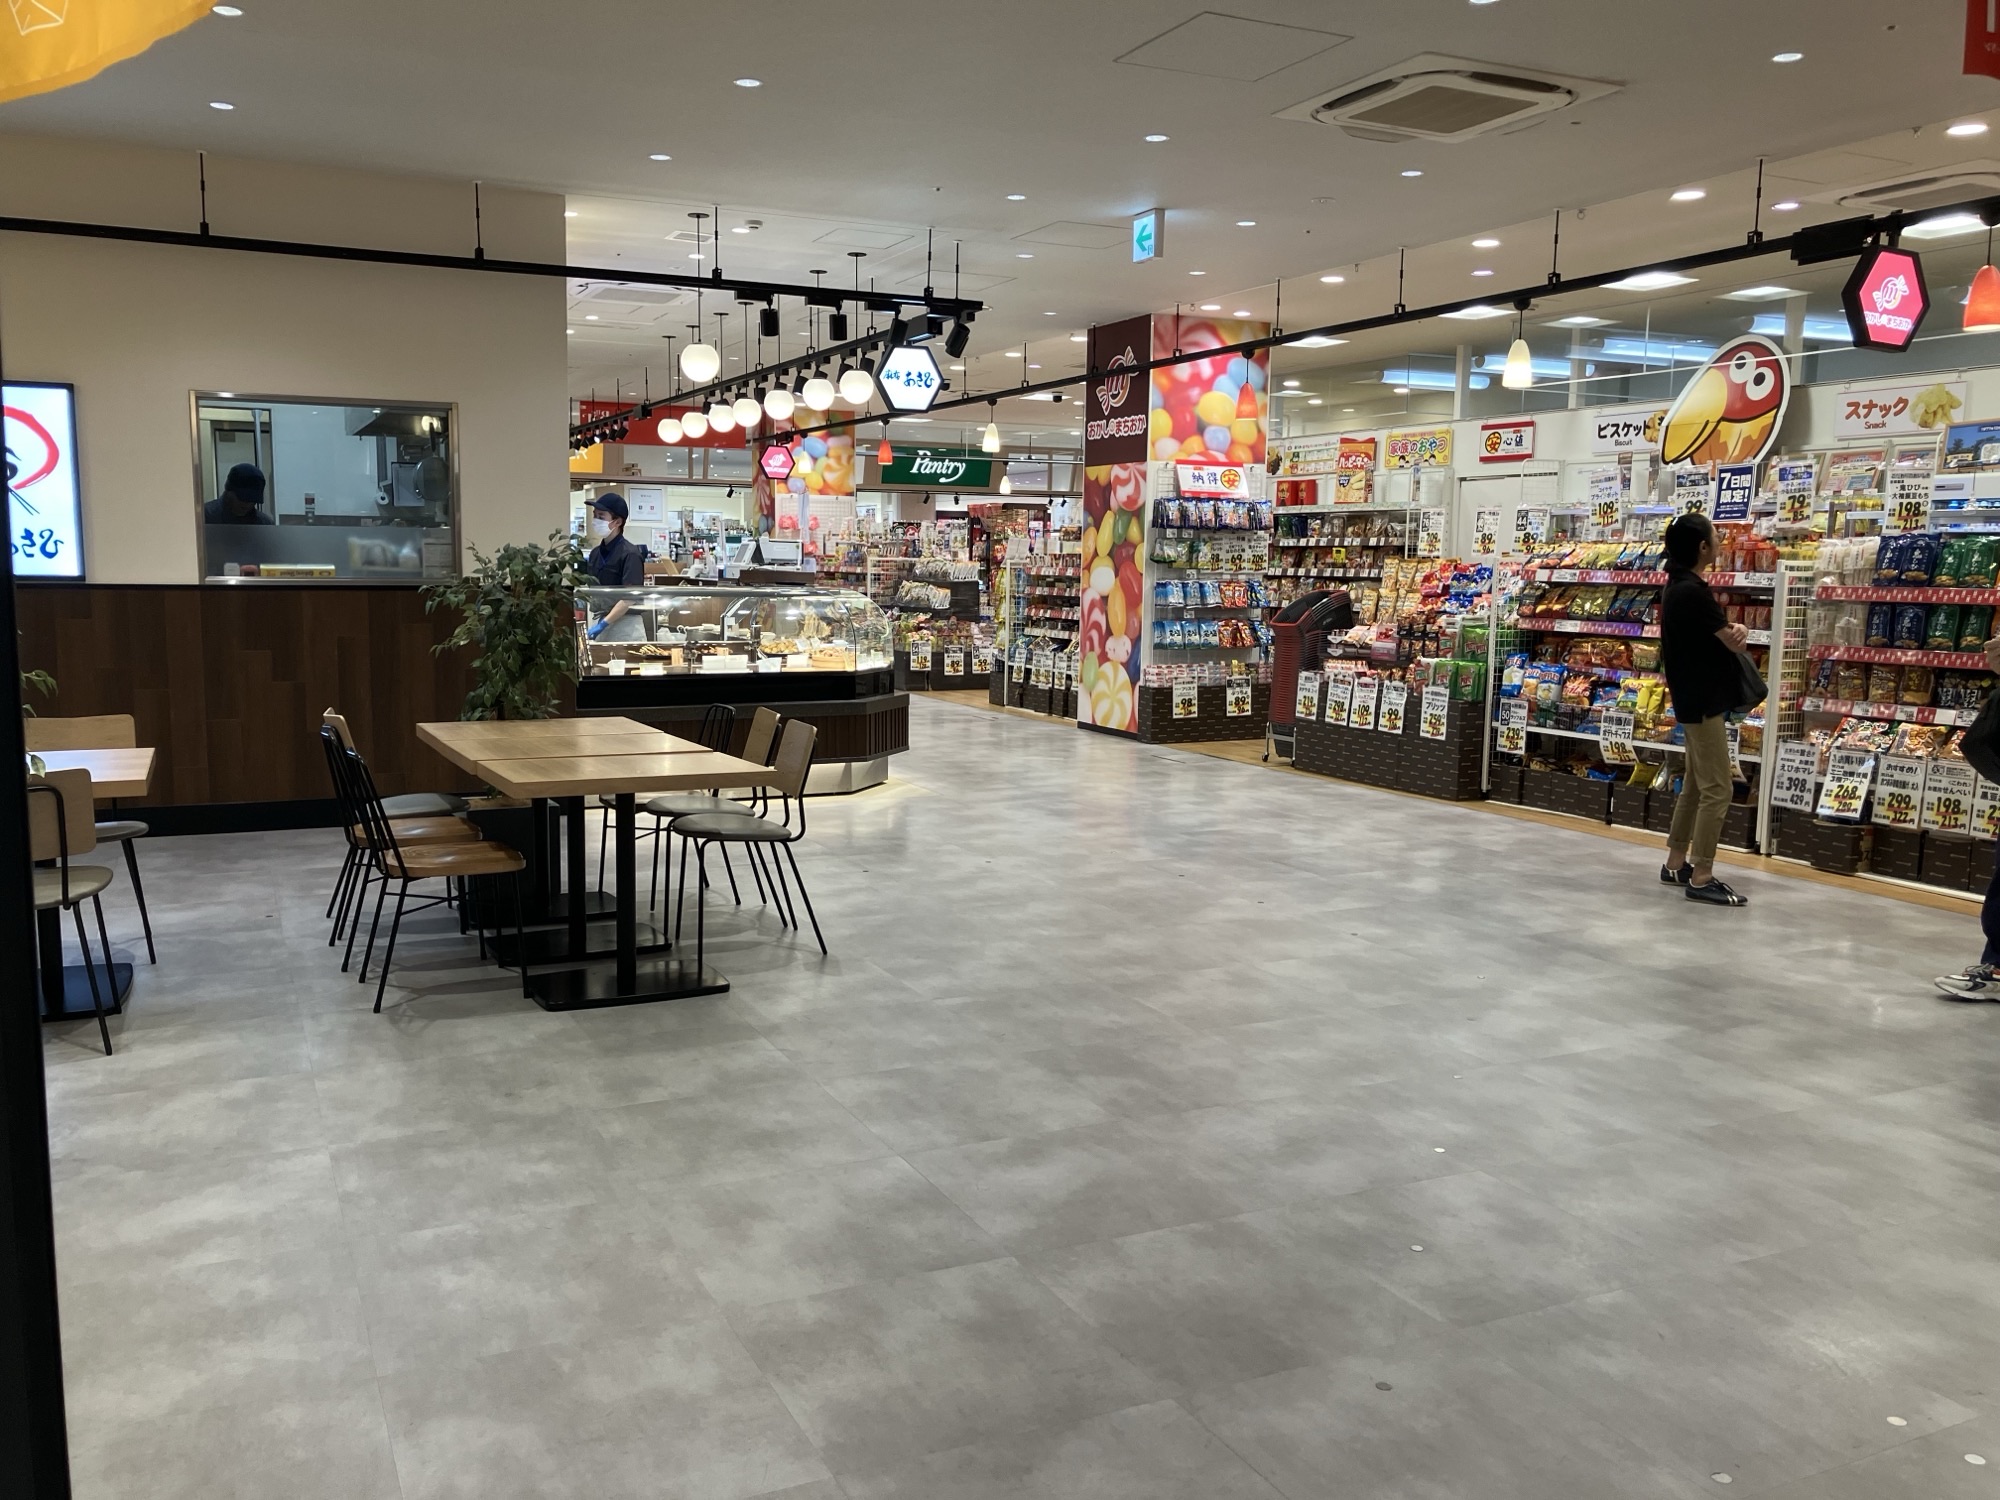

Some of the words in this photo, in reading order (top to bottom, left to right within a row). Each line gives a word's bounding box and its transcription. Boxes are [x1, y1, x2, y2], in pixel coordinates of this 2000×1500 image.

[904, 370, 935, 388] あさひ
[1845, 396, 1909, 420] スナック
[1087, 415, 1146, 440] おかしのまちおか
[1597, 420, 1647, 439] ビスケット
[1864, 420, 1887, 430] Snack
[1389, 436, 1447, 456] 家族のおやつ
[1614, 439, 1632, 447] Biscuit
[909, 450, 966, 483] Pantry
[1720, 472, 1751, 489] 7日間
[1720, 489, 1749, 503] 限定!
[1780, 764, 1813, 775] えびホマレ
[1886, 764, 1918, 774] おすすめ!
[1786, 777, 1812, 794] 398円
[1834, 785, 1862, 800] 268円
[1790, 794, 1810, 806] 429円
[1887, 793, 1917, 811] 299円
[1980, 791, 1999, 802] 黒豆
[1937, 797, 1968, 815] 198円
[1940, 816, 1966, 830] 213円
